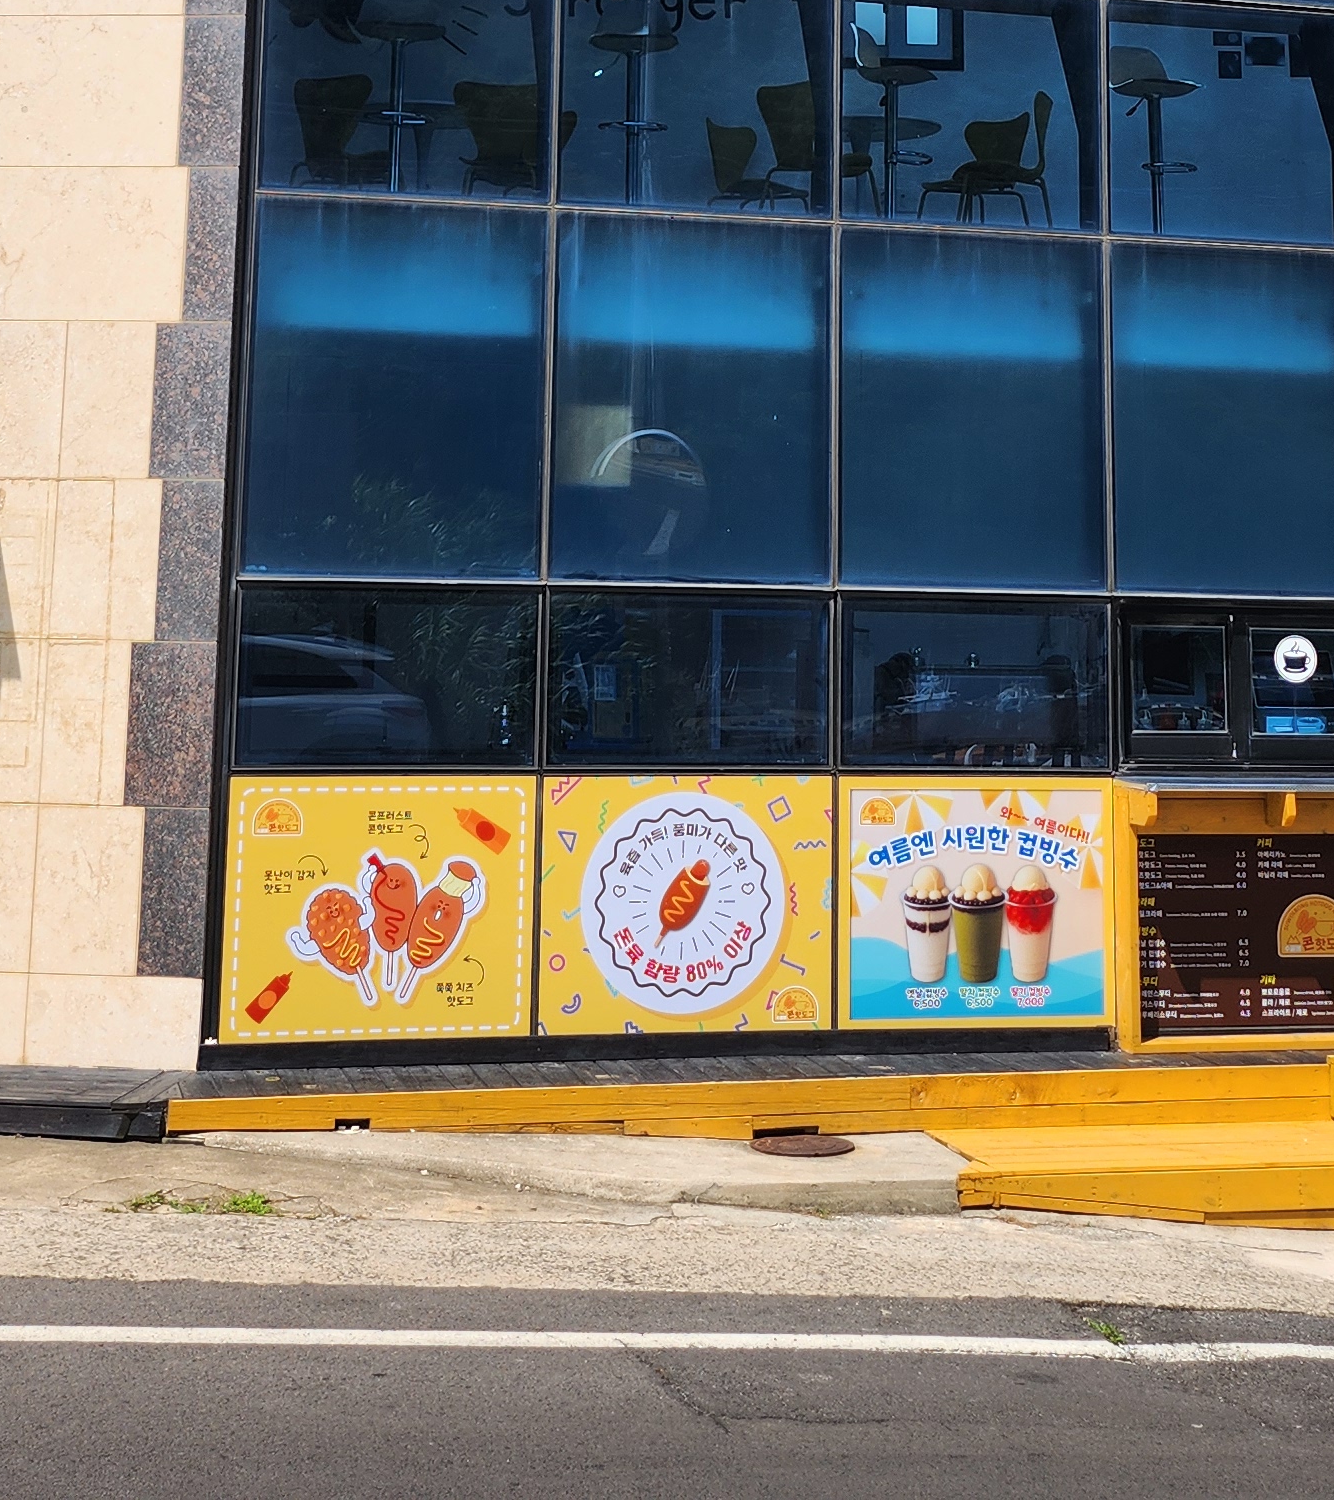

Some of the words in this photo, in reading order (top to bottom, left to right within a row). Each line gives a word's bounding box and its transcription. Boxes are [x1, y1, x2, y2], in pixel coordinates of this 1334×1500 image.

[1034, 816, 1090, 844] 여름이다!!
[638, 826, 669, 851] 가득!
[672, 823, 712, 840] 풍미가
[713, 832, 738, 858] 다른
[733, 856, 748, 873] 맛
[868, 831, 935, 866] 여름엔
[942, 825, 1010, 851] 시원한
[1017, 831, 1080, 870] 컵빙수
[1139, 838, 1156, 848] 도그
[264, 870, 293, 881] 못난이
[296, 869, 315, 881] 감자
[264, 883, 292, 895] 핫도그
[1140, 926, 1157, 937] 빙수
[643, 958, 681, 983] 함량
[686, 954, 724, 982] 80%
[723, 920, 752, 959] 이상
[455, 981, 474, 992] 치즈
[1142, 976, 1159, 986] 무디
[447, 996, 474, 1007] 핫도그
[913, 999, 941, 1008] 6,500
[967, 999, 993, 1008] 6,500
[1017, 997, 1044, 1007] 7,000
